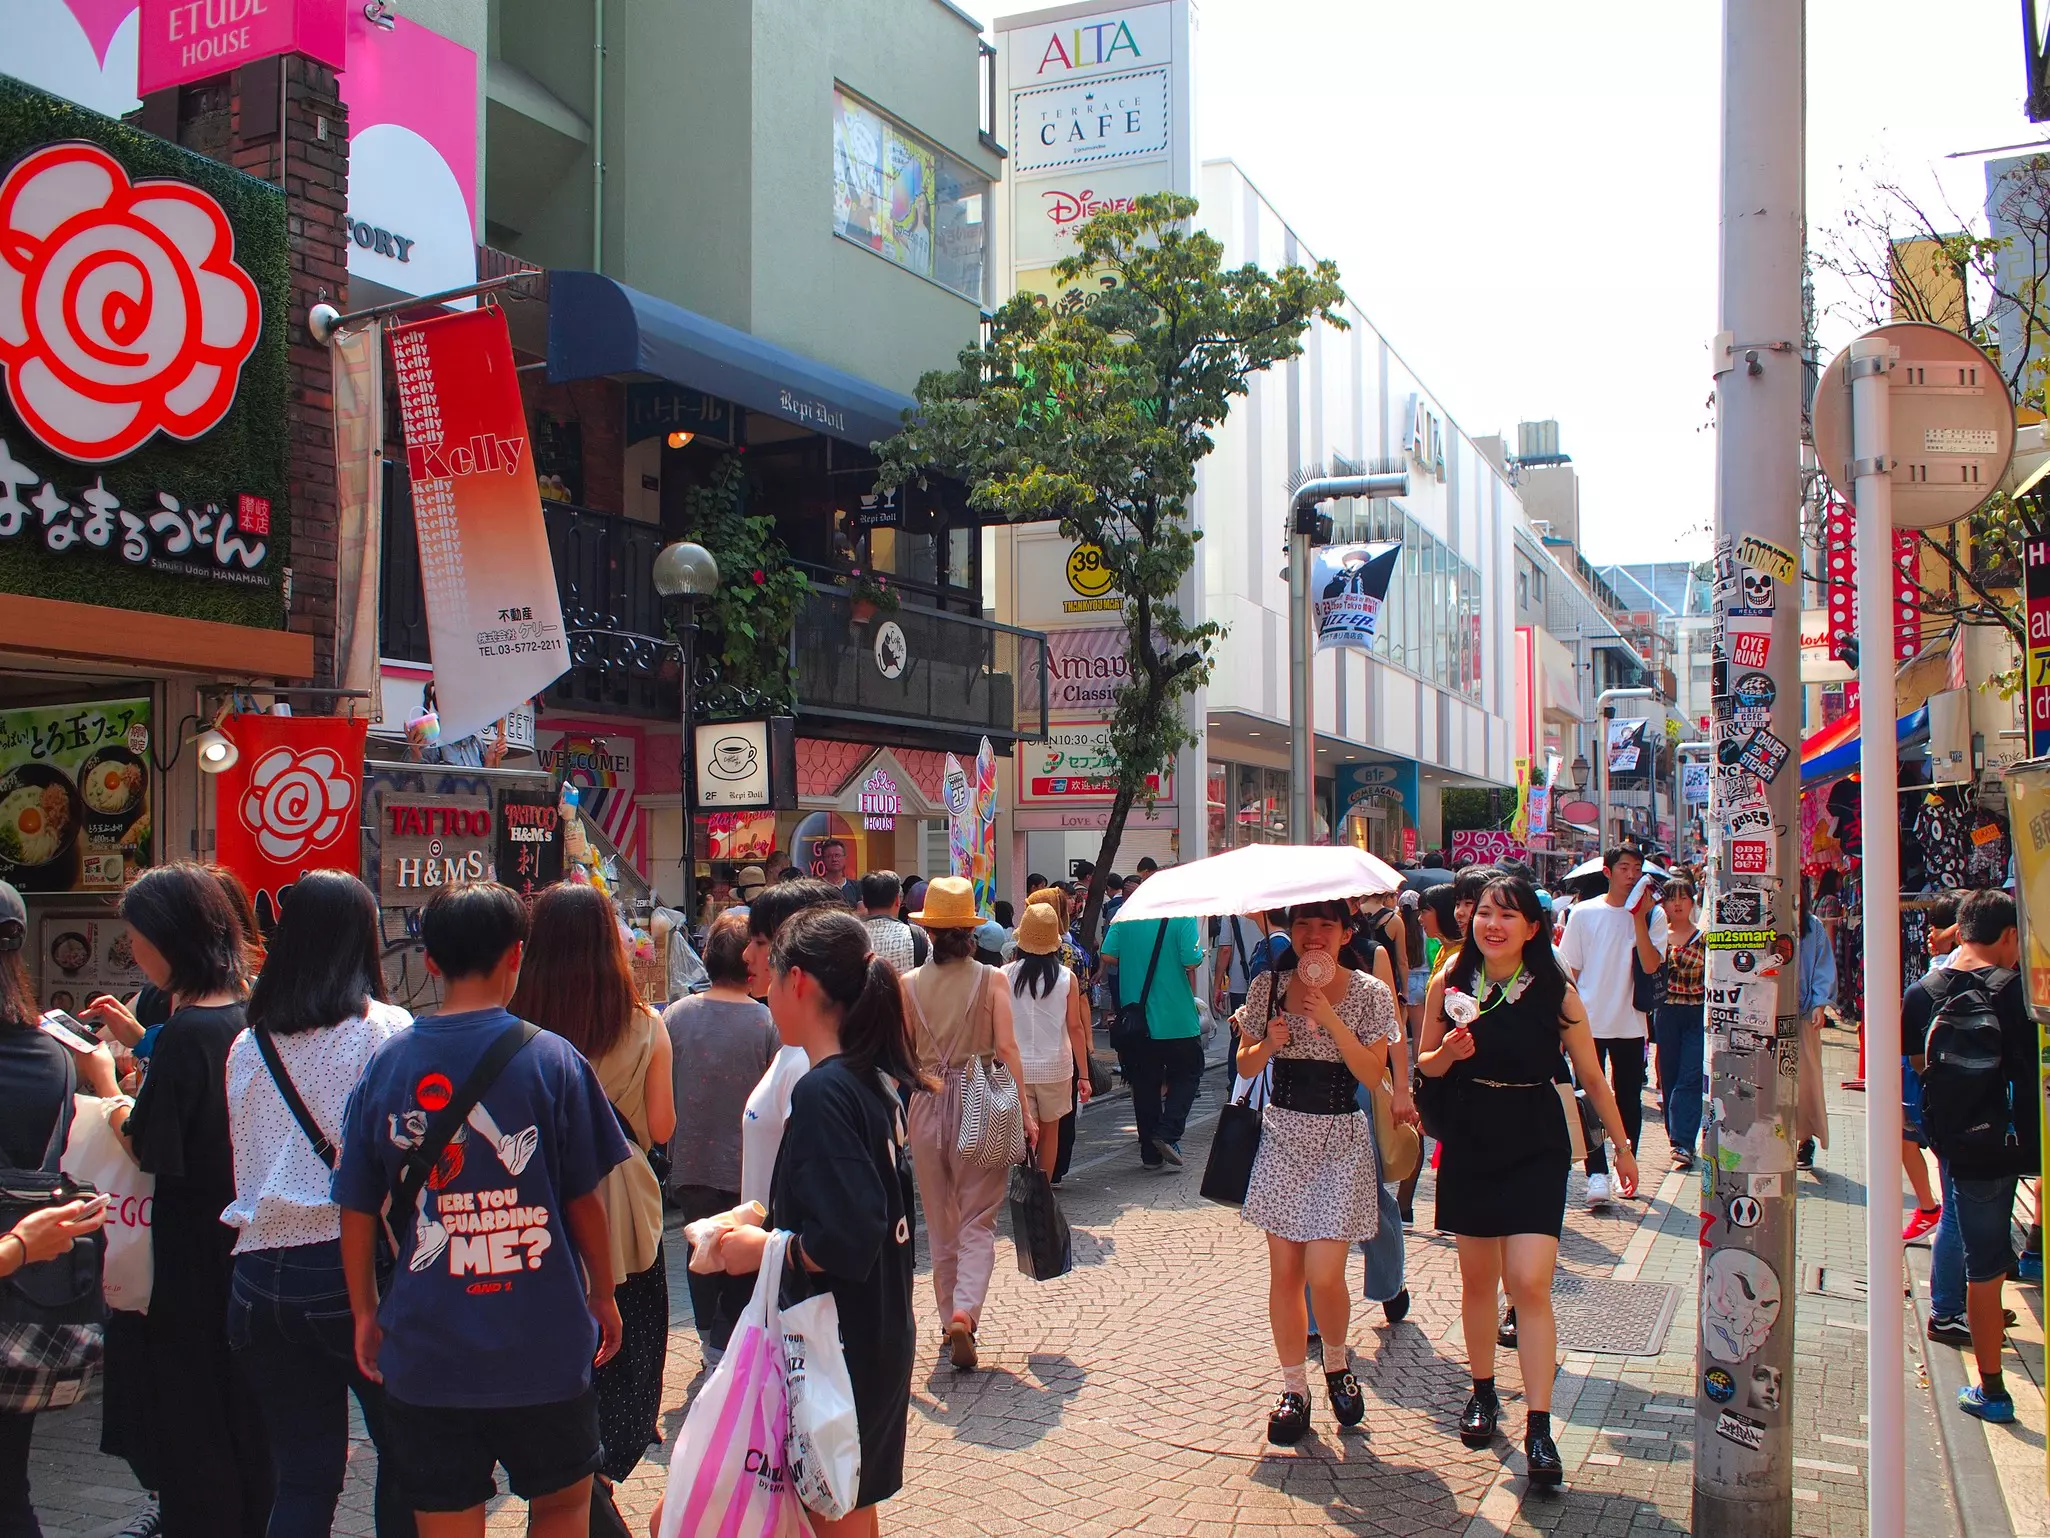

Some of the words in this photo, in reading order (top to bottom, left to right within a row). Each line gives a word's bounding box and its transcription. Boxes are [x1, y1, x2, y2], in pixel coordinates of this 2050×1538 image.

[181, 27, 250, 67] HOUSE
[1037, 20, 1141, 74] ALTA
[1041, 97, 1140, 120] TERRACE
[1041, 110, 1140, 146] CAFE
[392, 331, 425, 347] Kelly
[394, 344, 428, 359] Kelly
[396, 356, 430, 372] Kelly
[397, 368, 433, 384] Kelly
[399, 381, 435, 396] Kelly
[400, 393, 437, 409] Kelly
[402, 405, 440, 421] Kelly
[780, 389, 812, 422] Repi
[816, 402, 844, 431] Doll
[404, 417, 442, 433] Kelly
[406, 430, 445, 445] Kelly
[407, 433, 524, 482] Kelly
[412, 480, 453, 494] Kelly
[414, 491, 454, 506] Kelly
[415, 503, 456, 518] Kelly
[879, 512, 897, 522] Doll
[417, 516, 458, 530] Kelly
[418, 528, 460, 542] Kelly
[420, 540, 461, 554] Kelly
[422, 552, 463, 566] Kelly
[1073, 551, 1100, 572] 39
[1736, 537, 1795, 578] JOINTS
[151, 558, 184, 574] Sanuki
[185, 564, 210, 577] Udon
[213, 571, 270, 586] HANAMARU
[424, 564, 464, 578] Kelly
[426, 576, 466, 590] Kelly
[1063, 600, 1088, 613] THANK
[1088, 599, 1103, 612] YOU
[1103, 598, 1125, 611] MART
[1344, 601, 1361, 610] Tokyo
[498, 606, 533, 623] 不動産
[476, 629, 517, 645] 株式会社
[518, 621, 557, 639] ケリー
[479, 639, 561, 657] TEL.03-5772-2211
[1740, 635, 1765, 651] OYE
[1734, 650, 1765, 667] RUNS
[1741, 713, 1763, 721] CCFC
[31, 709, 135, 759] とろ玉フェア
[1751, 746, 1762, 757] 20
[1754, 731, 1787, 760] DAUER
[536, 749, 630, 773] WELCOME!
[1740, 753, 1775, 780] STEHER
[1365, 768, 1384, 782] B1F
[705, 791, 717, 801] 2F
[729, 791, 746, 800] Repi
[747, 790, 763, 799] Doll
[952, 787, 965, 807] 2F
[1350, 787, 1373, 802] COME
[858, 793, 902, 814] ETUDE
[388, 805, 491, 837] TATTOO
[504, 803, 558, 832] TATTOO
[864, 817, 896, 831] HOUSE
[1061, 814, 1091, 826] LOVE
[1734, 853, 1763, 861] MAN
[1734, 861, 1763, 869] OUT
[397, 850, 483, 888] H&MS
[1711, 1009, 1740, 1022] GOLD
[477, 1187, 518, 1209] YOU
[443, 1206, 549, 1235] GUARDING
[450, 1227, 552, 1276] ME?
